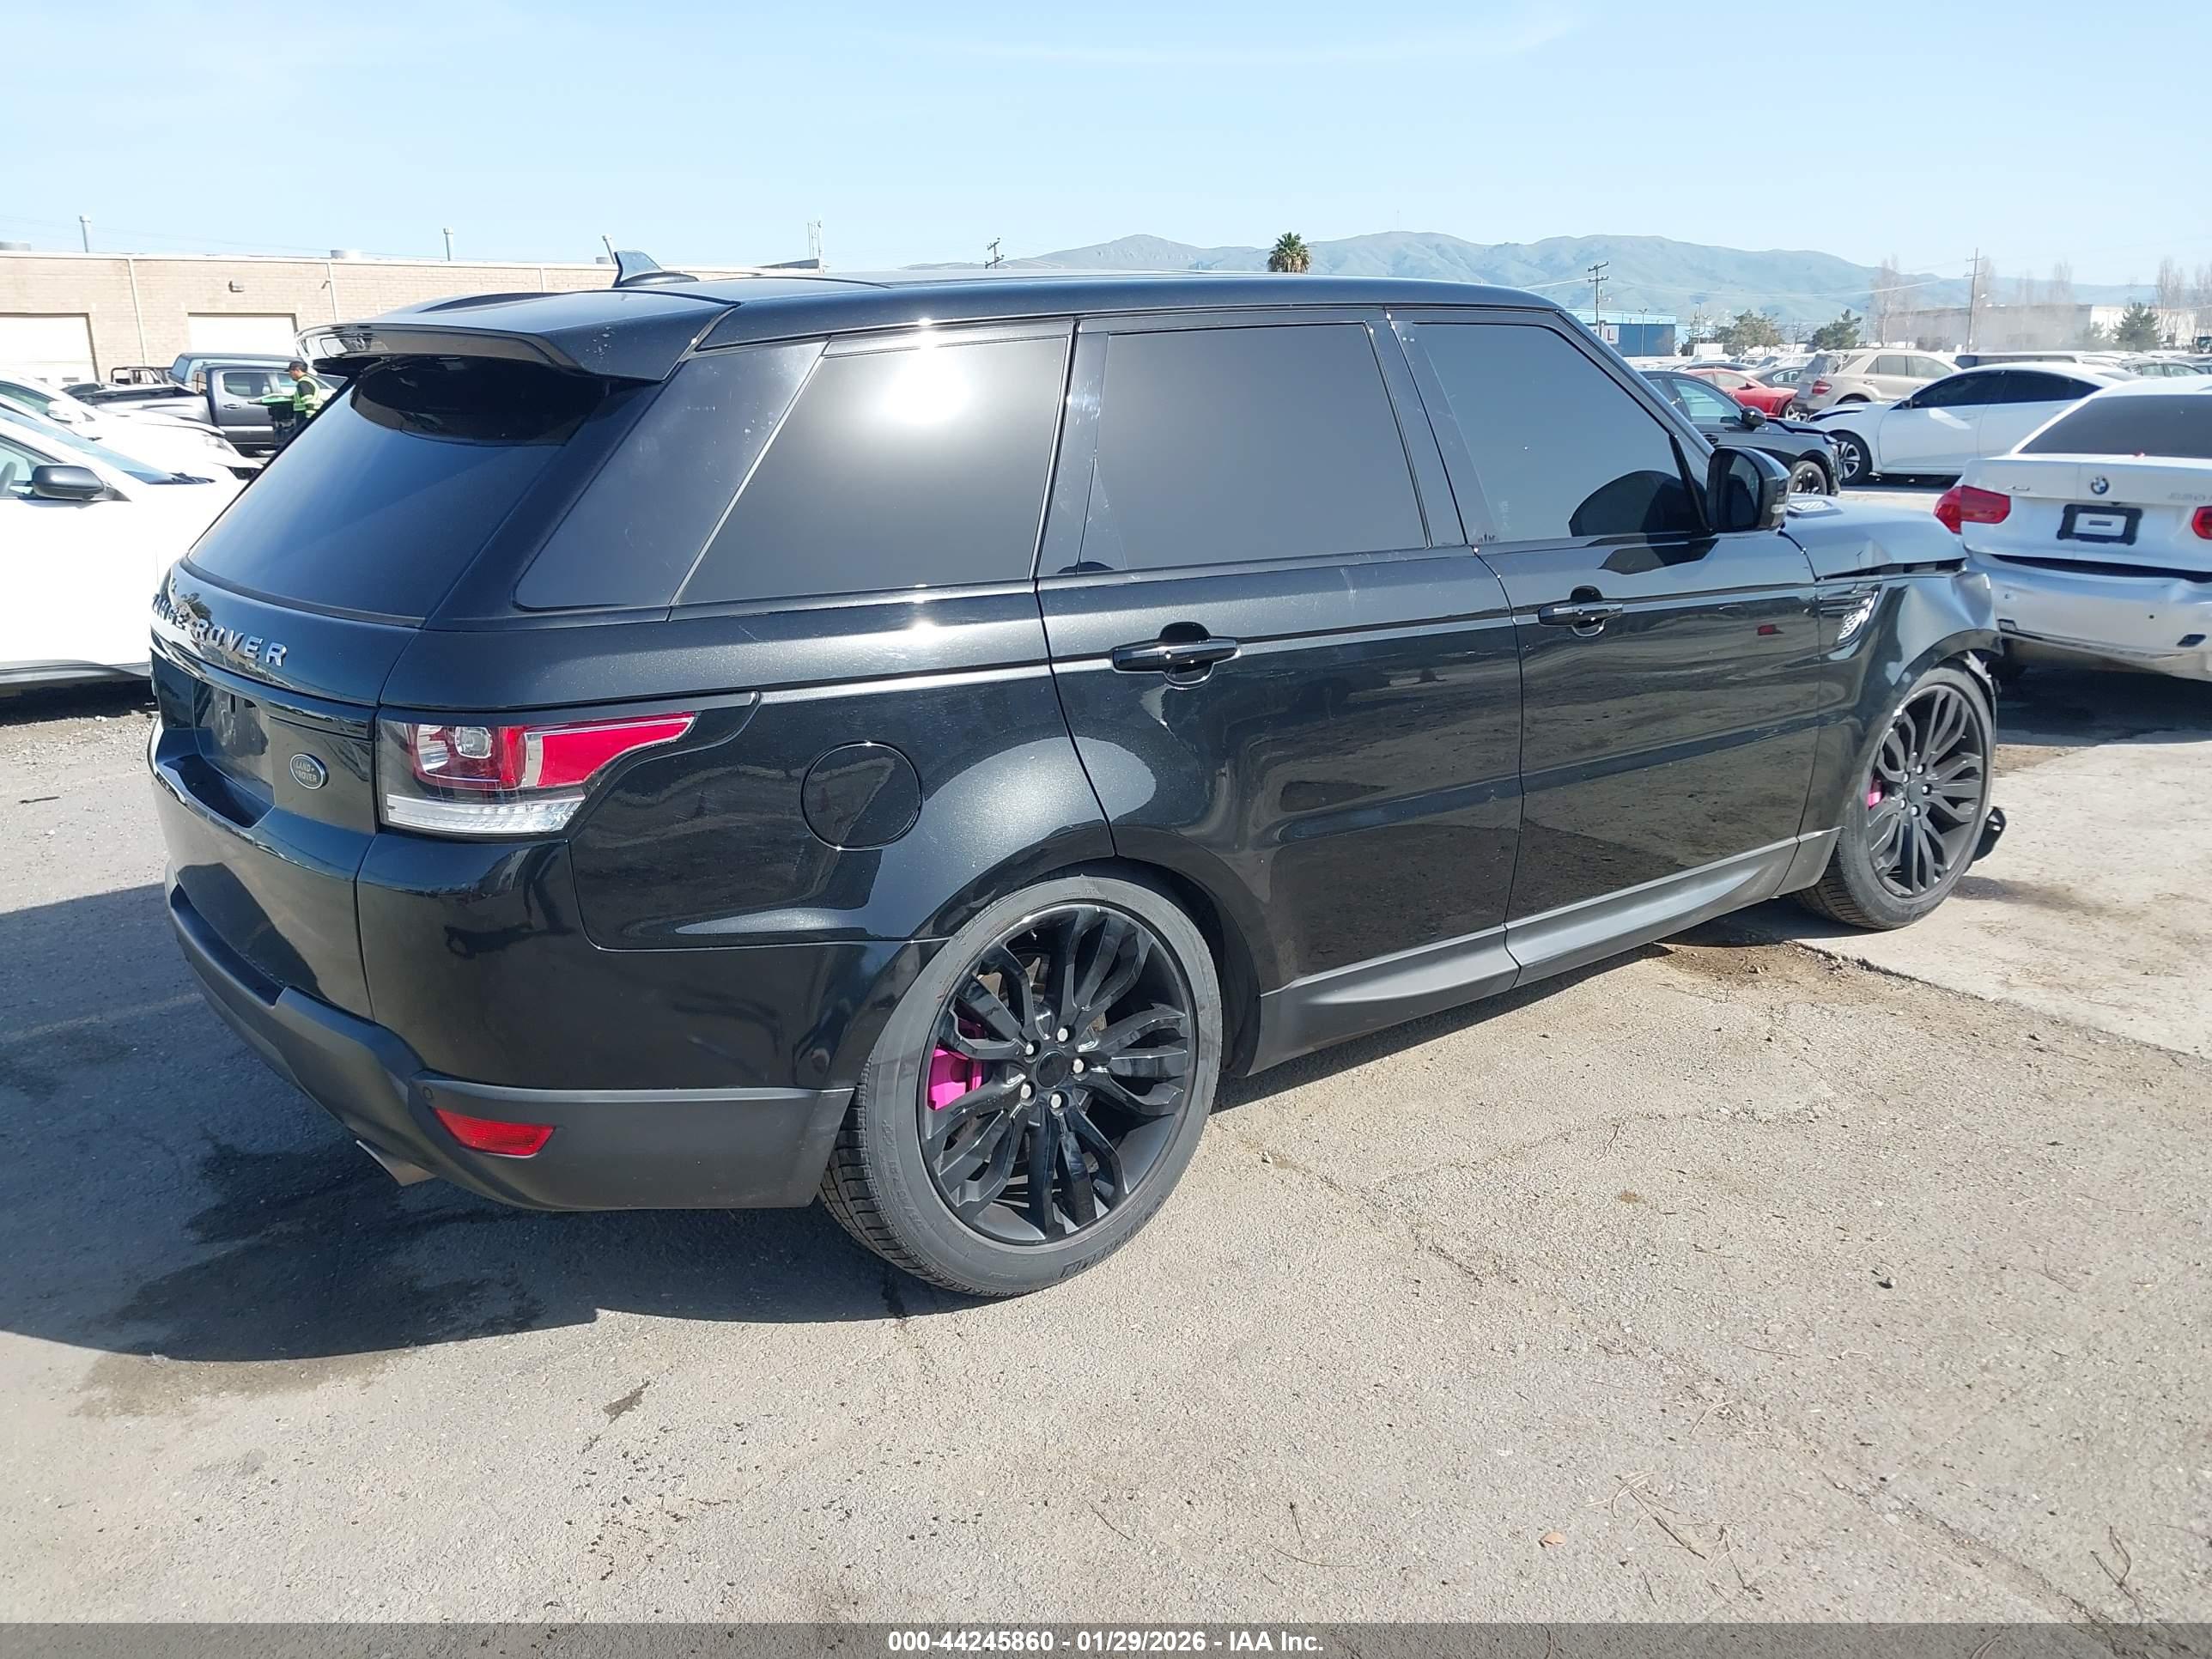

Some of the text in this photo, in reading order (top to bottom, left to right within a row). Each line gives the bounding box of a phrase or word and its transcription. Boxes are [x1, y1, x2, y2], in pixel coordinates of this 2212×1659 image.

[195, 617, 288, 667] ROVER
[295, 760, 311, 772] LAND
[298, 769, 318, 784] ROVER
